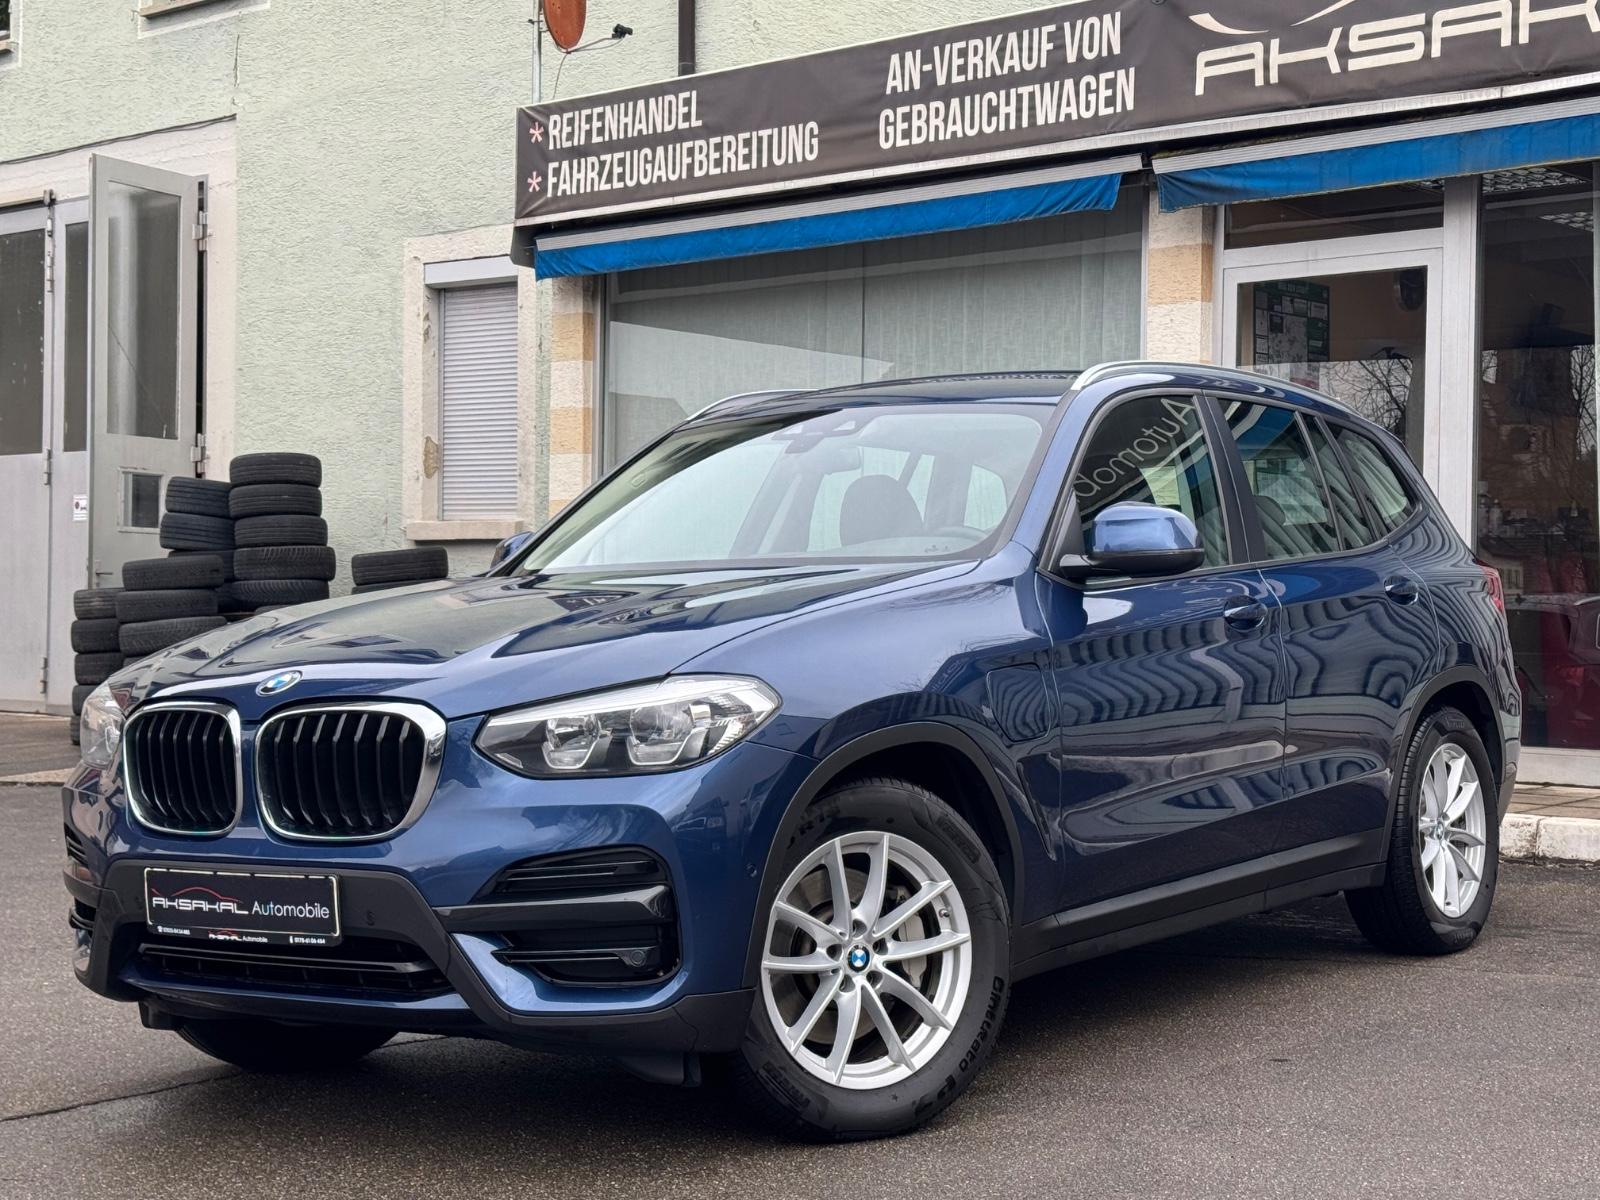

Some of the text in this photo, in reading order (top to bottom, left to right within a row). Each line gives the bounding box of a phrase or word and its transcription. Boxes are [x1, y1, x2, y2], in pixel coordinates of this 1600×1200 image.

[886, 11, 1122, 95] AN-VERKAUF VON
[547, 91, 702, 151] REIFENHANDEL
[879, 67, 1135, 150] GEBRAUCHTWAGEN
[546, 122, 819, 198] FAHRZEUGAUFBEREITUNG
[152, 896, 330, 919] AKSAKAL Automobile
